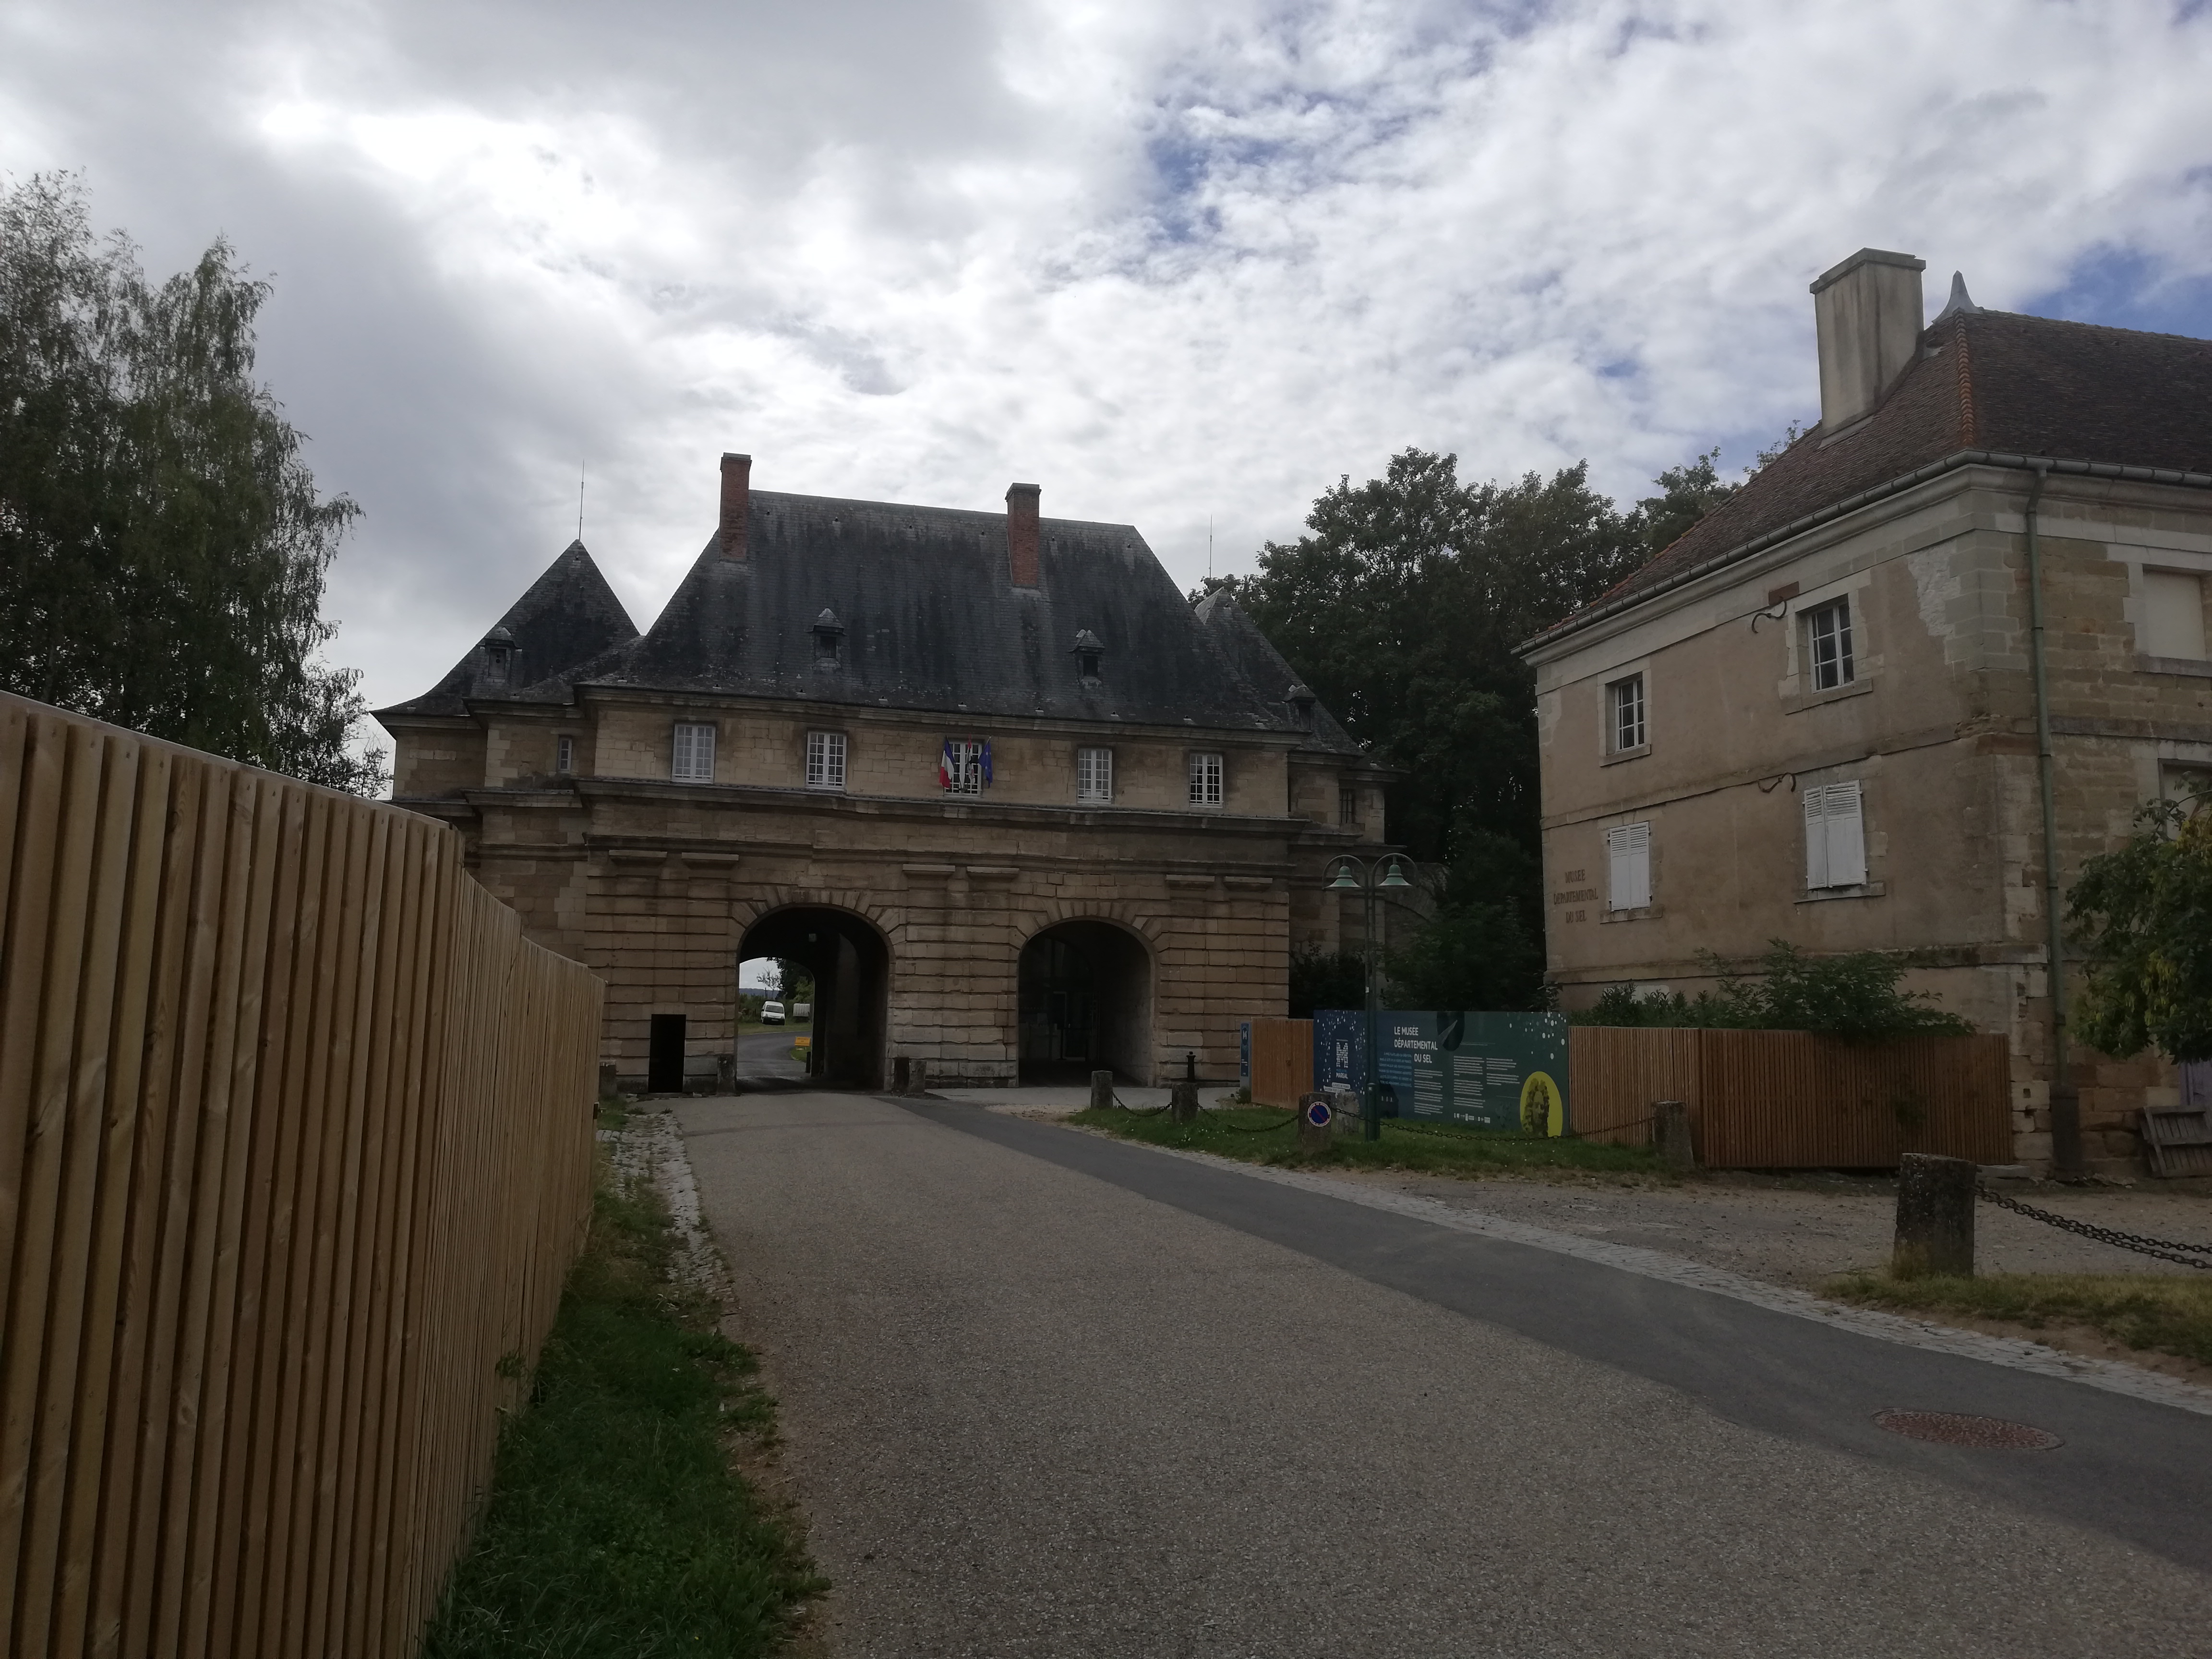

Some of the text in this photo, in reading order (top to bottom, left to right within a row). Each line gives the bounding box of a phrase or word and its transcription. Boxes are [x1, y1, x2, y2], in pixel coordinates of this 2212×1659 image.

[1565, 869, 1586, 883] MUSEE
[1553, 888, 1599, 905] DEPARTEMENTAL
[1566, 910, 1587, 923] DU SEL
[1394, 1025, 1419, 1035] LE MUSÉE
[1394, 1037, 1438, 1050] DÉPARTEMENTAL
[1414, 1053, 1432, 1063] DU SEL
